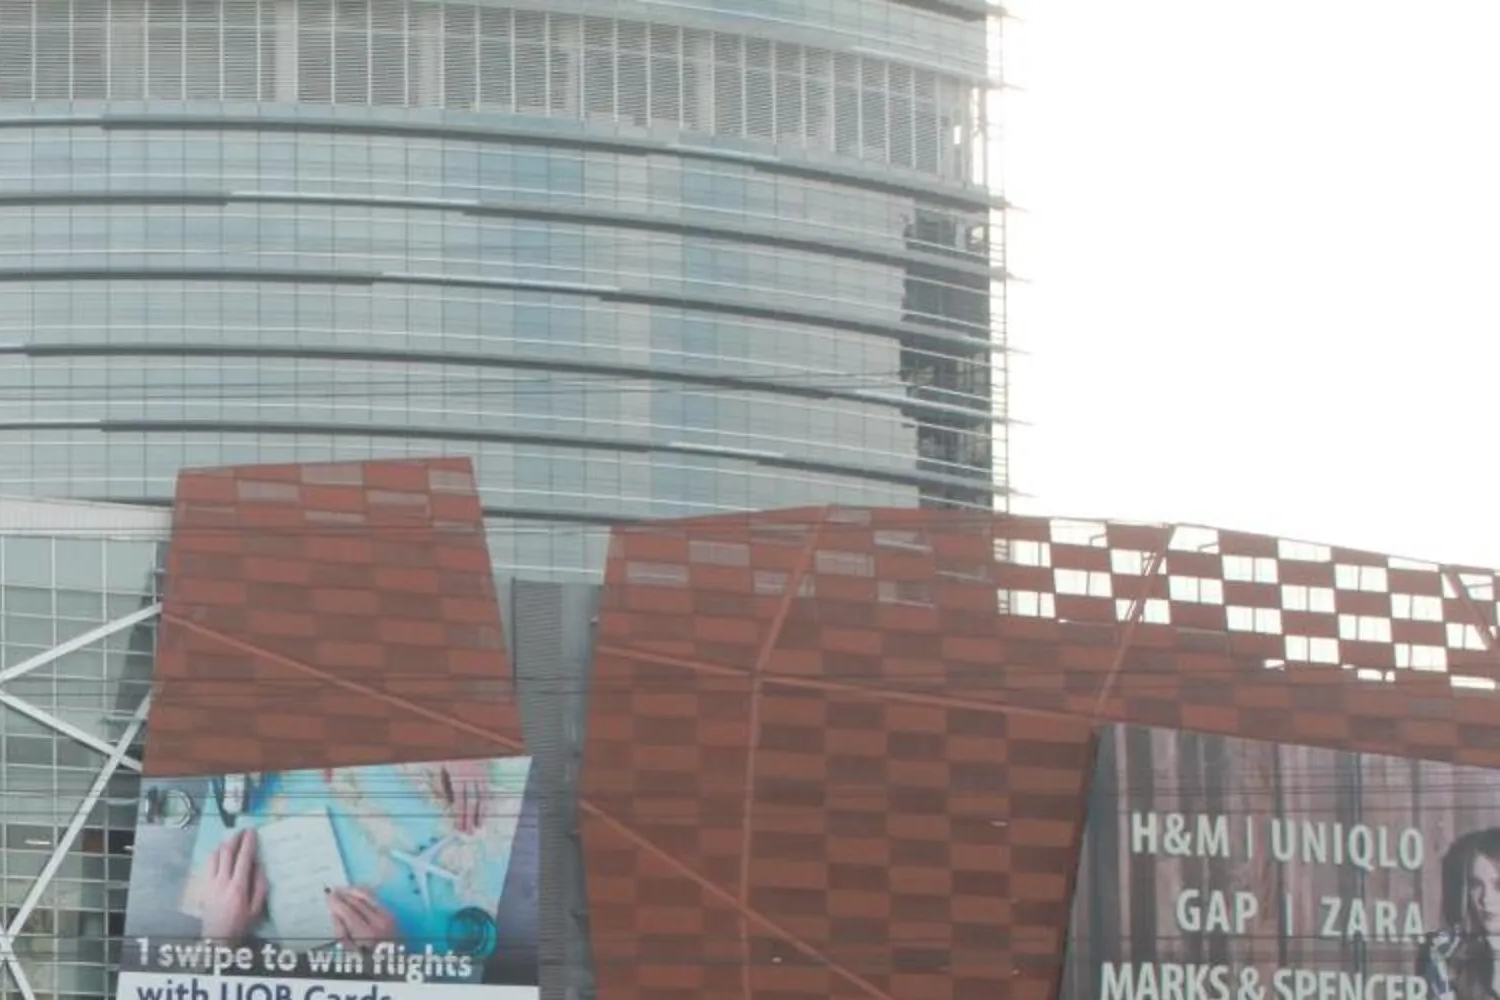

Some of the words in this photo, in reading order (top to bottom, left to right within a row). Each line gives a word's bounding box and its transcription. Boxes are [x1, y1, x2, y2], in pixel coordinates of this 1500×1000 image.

[1132, 812, 1230, 857] H&M
[1272, 819, 1425, 870] UNIQLO
[1176, 889, 1258, 934] GAP
[1320, 897, 1426, 943] ZARA
[137, 938, 148, 966] 1
[159, 938, 253, 976] swipe
[261, 943, 297, 971] to
[308, 943, 364, 974] win
[372, 941, 473, 983] flights
